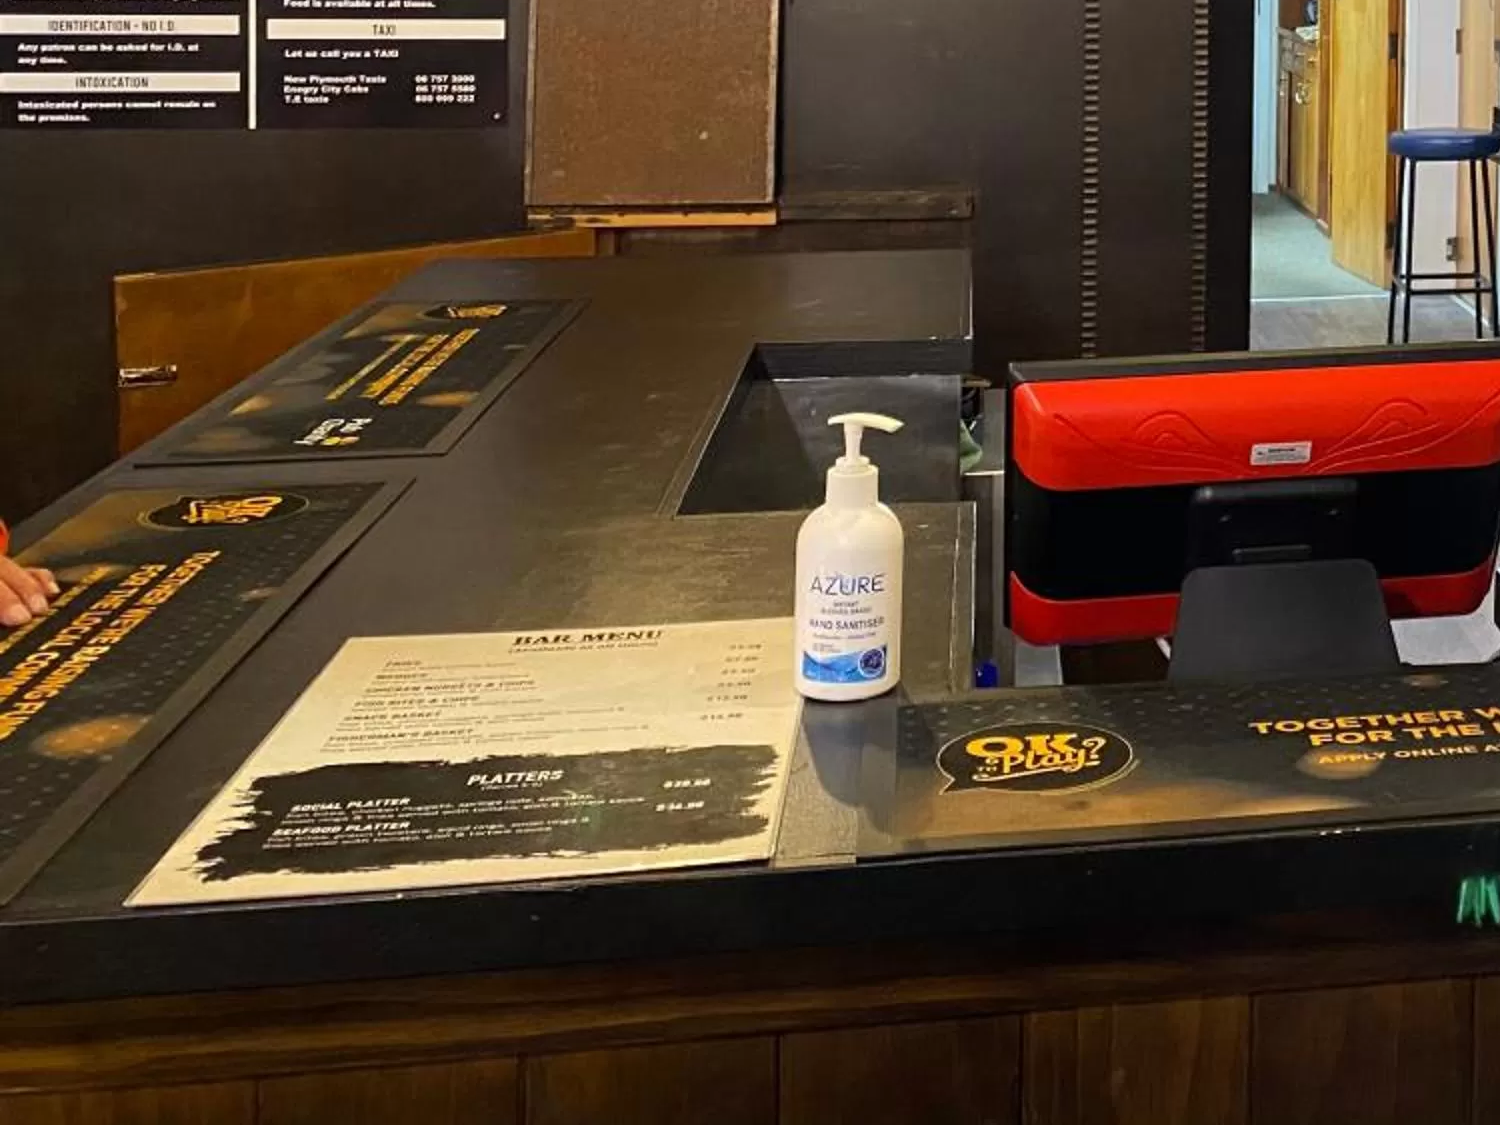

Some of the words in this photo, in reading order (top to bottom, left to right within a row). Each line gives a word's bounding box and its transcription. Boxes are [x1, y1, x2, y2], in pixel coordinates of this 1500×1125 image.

[48, 20, 131, 32] IDENTIFICATION
[372, 24, 396, 35] TAXI
[374, 50, 399, 58] TAXI
[75, 77, 149, 88] INTOXICATION
[809, 573, 885, 595] AZURE
[809, 619, 833, 630] HAND
[512, 634, 571, 646] BAR
[580, 630, 664, 642] MENU
[1248, 709, 1467, 735] TOGETHER
[1309, 730, 1398, 747] FOR
[1402, 723, 1485, 741] THE
[966, 732, 1079, 758] OK
[1318, 750, 1387, 765] APPLY
[1394, 743, 1479, 759] ONLINE
[468, 769, 563, 786] PLATTERS
[291, 801, 343, 813] SOCIAL
[346, 797, 411, 810] PLATTER
[271, 825, 344, 836] SEAFOOD
[348, 821, 411, 832] PLATTER
